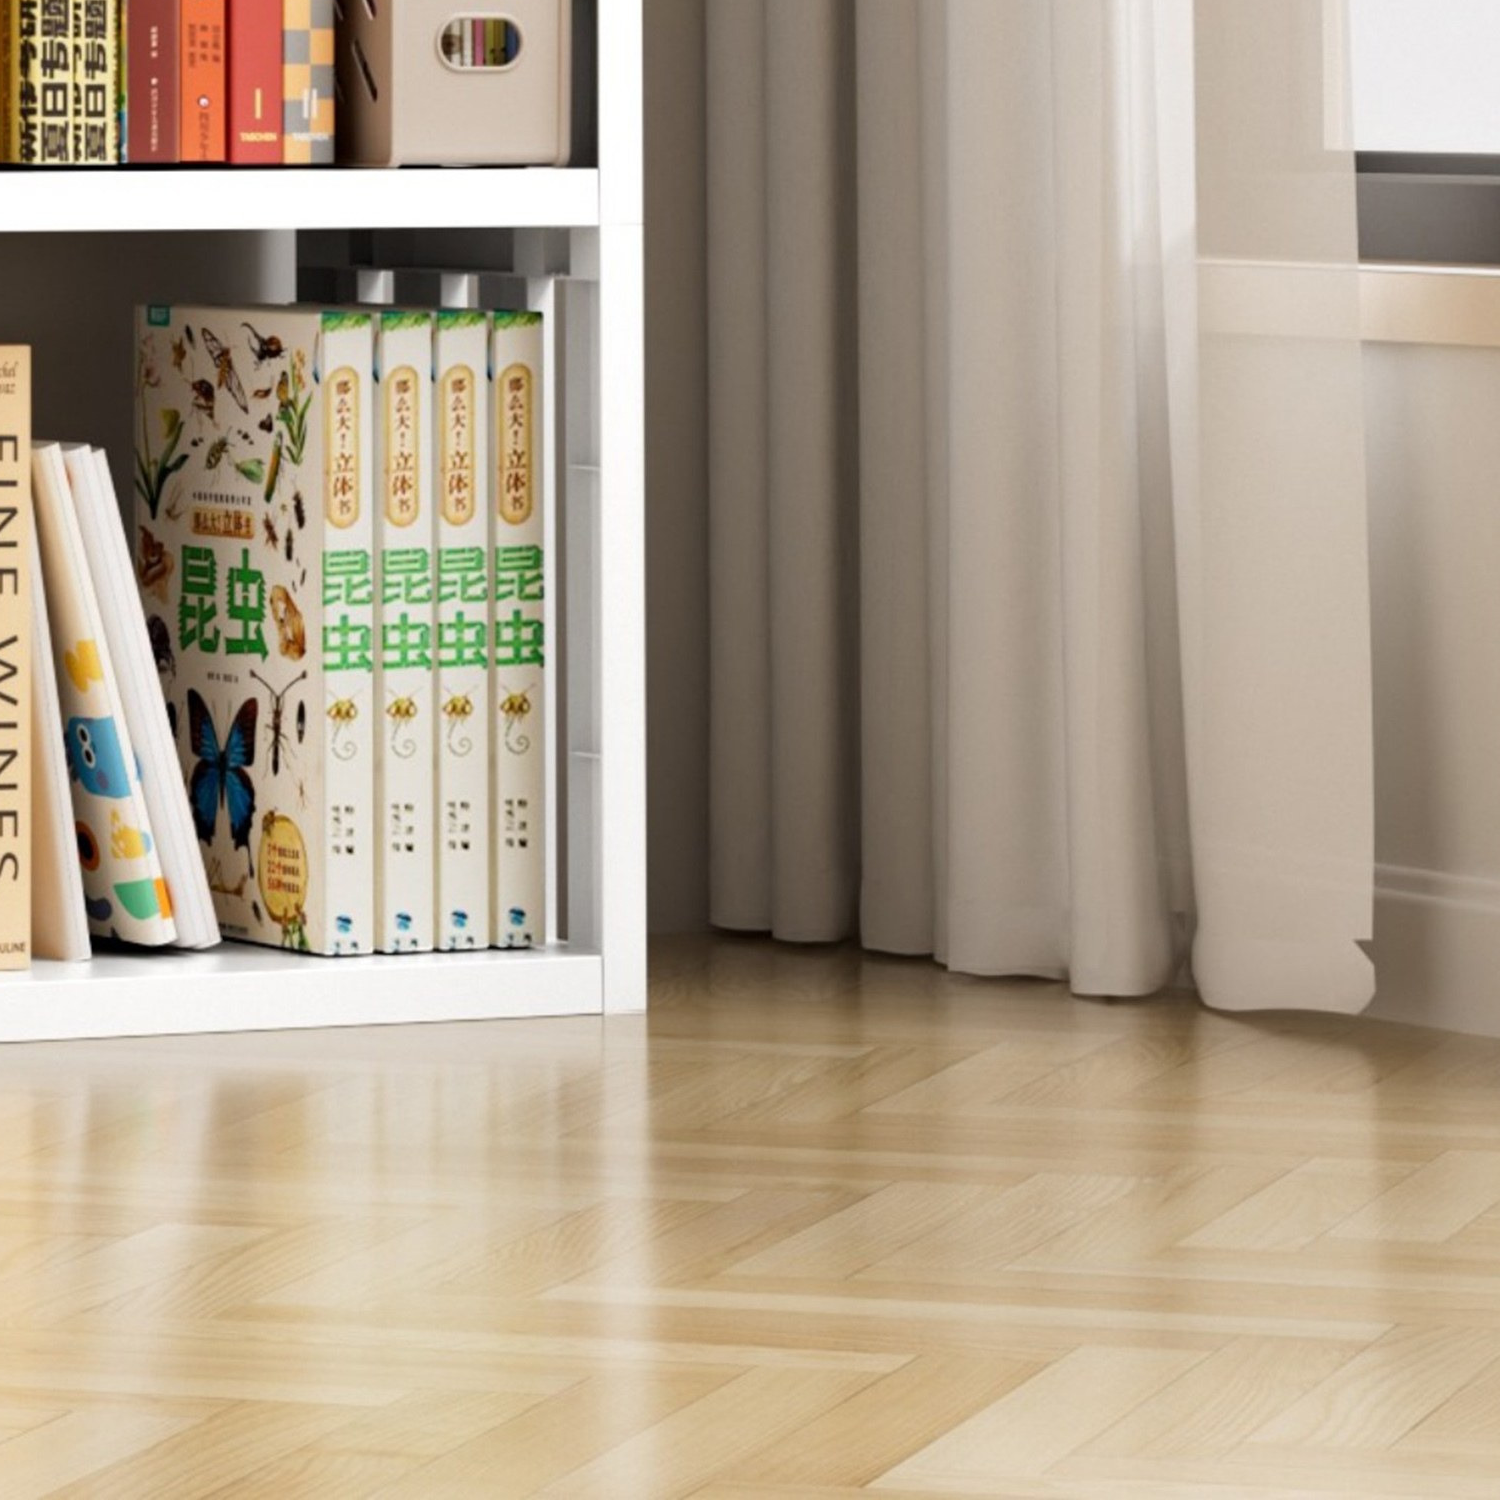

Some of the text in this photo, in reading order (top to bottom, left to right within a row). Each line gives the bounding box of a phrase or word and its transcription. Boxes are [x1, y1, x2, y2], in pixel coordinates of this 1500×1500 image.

[178, 544, 269, 663] 昆虫
[322, 550, 373, 672] 昆虫
[382, 547, 432, 670] 昆虫
[438, 546, 488, 669] 昆虫
[495, 544, 544, 668] 昆虫
